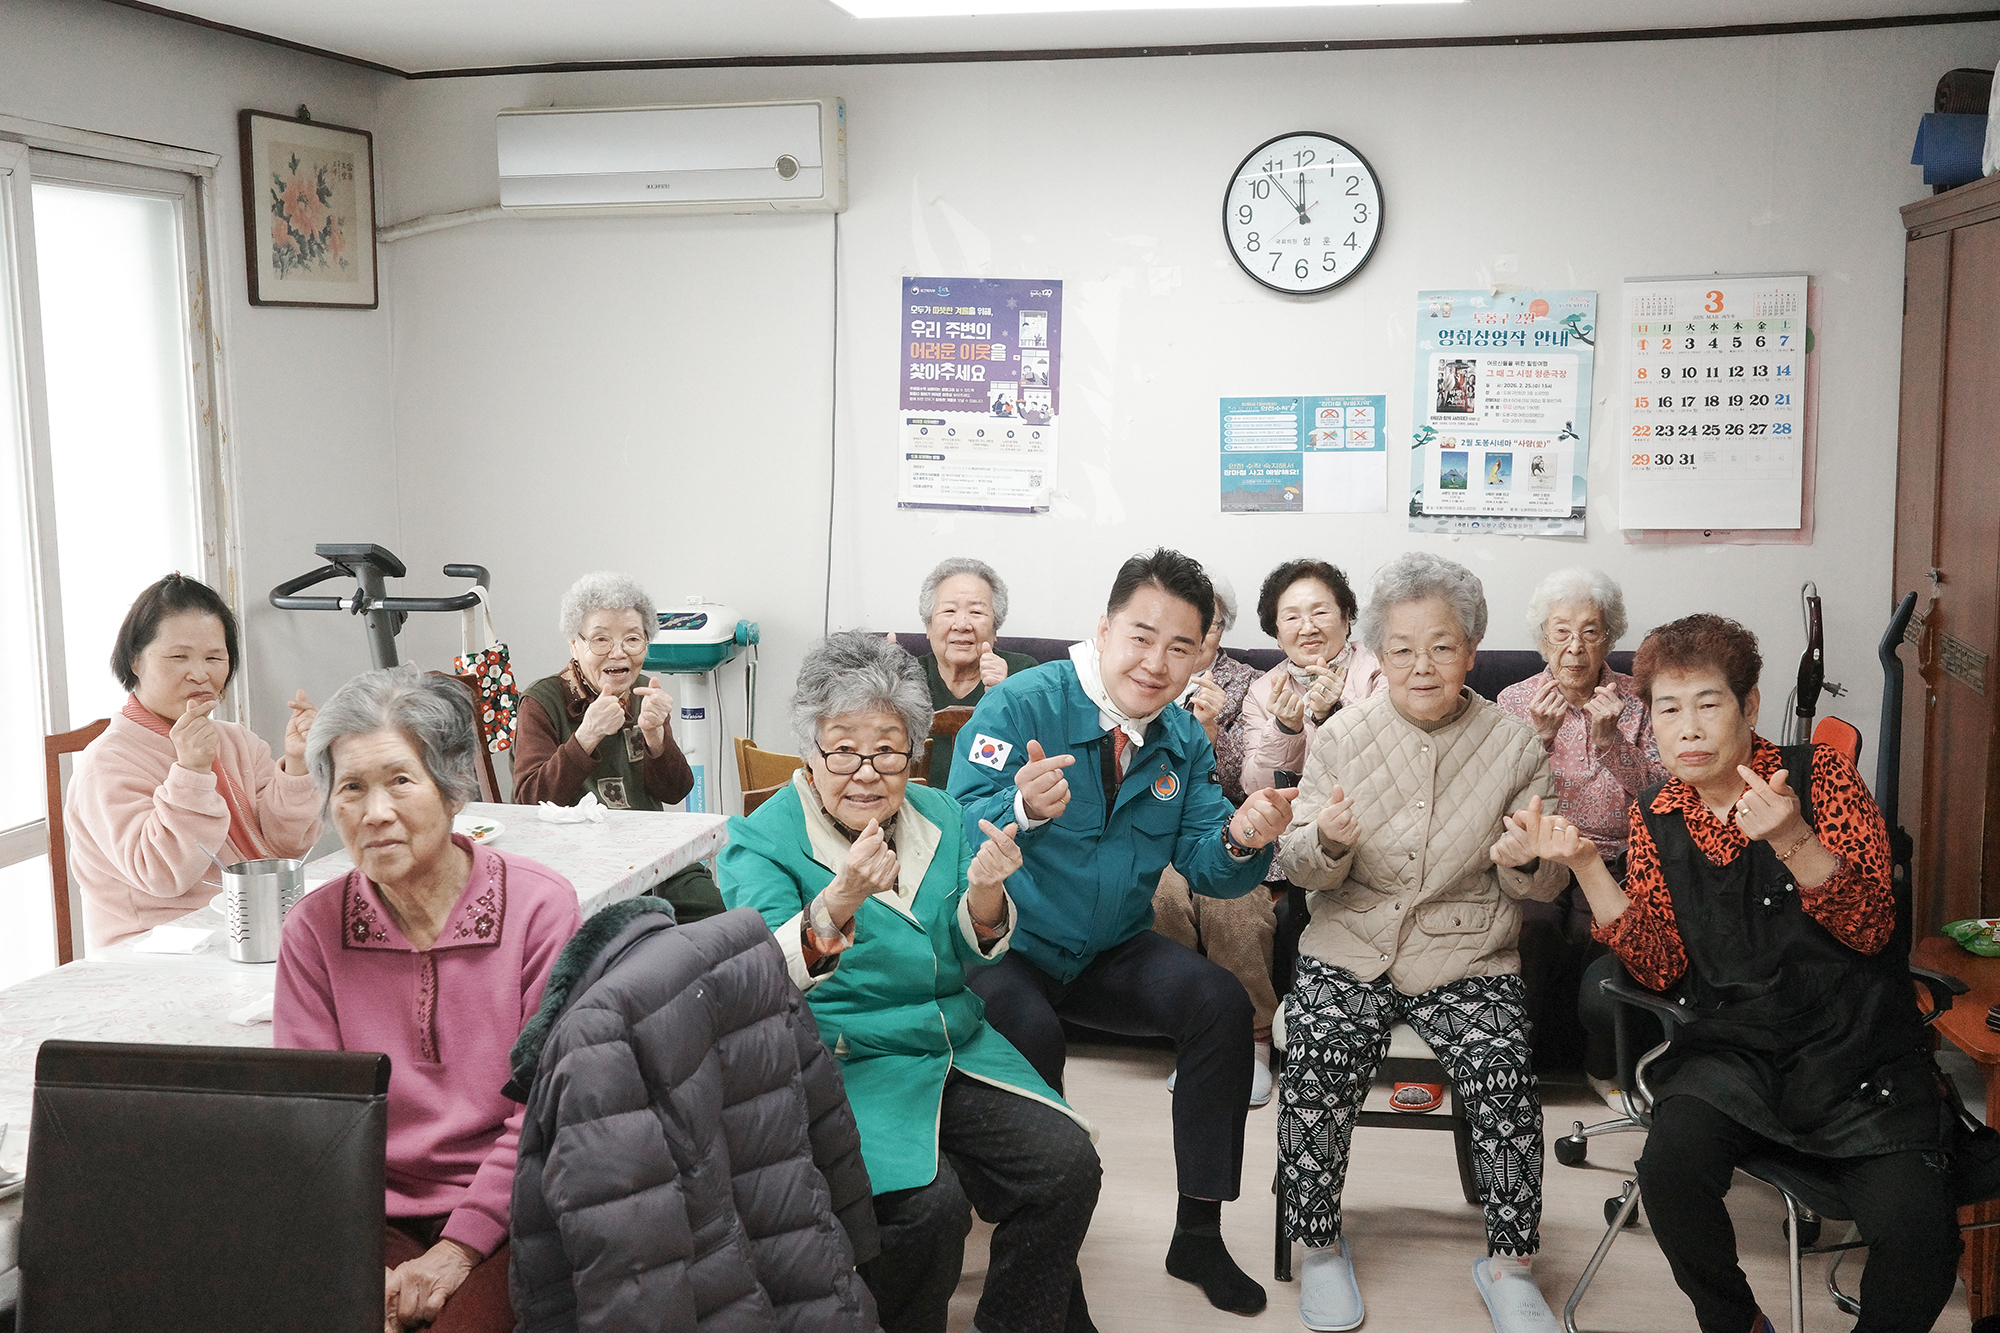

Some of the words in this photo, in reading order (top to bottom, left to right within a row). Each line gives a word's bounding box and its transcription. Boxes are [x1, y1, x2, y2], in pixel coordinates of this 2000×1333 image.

[1265, 160, 1283, 178] 11
[1293, 150, 1315, 169] 12
[1326, 158, 1334, 177] 1
[1249, 180, 1270, 199] 10
[1345, 176, 1359, 195] 2
[1239, 205, 1252, 224] 9
[1354, 204, 1367, 223] 3
[1247, 232, 1260, 251] 8
[1343, 232, 1357, 251] 4
[1269, 252, 1282, 271] 7
[1295, 259, 1308, 278] 6
[1322, 252, 1336, 271] 5
[910, 305, 931, 314] 모두가
[1705, 290, 1724, 313] 3
[1473, 312, 1510, 324] 도봉구
[1515, 312, 1535, 325] 2월
[1662, 324, 1672, 332] 月
[1686, 323, 1695, 331] 火
[1709, 322, 1719, 331] 水
[1758, 321, 1766, 330] 金
[910, 320, 941, 339] 우리
[945, 321, 991, 340] 주변의
[1438, 329, 1526, 347] 영화상영작
[1534, 329, 1569, 347] 안내
[910, 342, 956, 360] 어려운
[960, 343, 1007, 362] 이웃을
[1639, 339, 1646, 350] 1
[1662, 338, 1671, 349] 2
[1685, 338, 1695, 349] 3
[1708, 338, 1718, 348] 4
[1732, 337, 1742, 348] 5
[1755, 336, 1765, 347] 6
[1780, 335, 1789, 346] 7
[909, 362, 986, 382] 찾아주세요
[1506, 370, 1514, 378] 그
[1516, 370, 1532, 378] 시절
[1534, 370, 1567, 378] 청춘극장
[1637, 368, 1647, 379] 8
[1661, 367, 1671, 378] 9
[1682, 367, 1697, 378] 10
[1706, 367, 1718, 378] 11
[1729, 366, 1744, 377] 12
[1753, 365, 1768, 376] 13
[1776, 365, 1791, 376] 14
[1635, 397, 1649, 408] 15
[1658, 396, 1672, 407] 16
[1681, 396, 1696, 407] 17
[1704, 395, 1719, 407] 18
[1728, 395, 1743, 406] 19
[1750, 394, 1769, 406] 20
[1775, 394, 1790, 405] 21
[1632, 425, 1651, 436] 22
[1655, 425, 1674, 436] 23
[1678, 425, 1697, 436] 24
[1702, 424, 1720, 436] 25
[1725, 424, 1744, 435] 26
[1749, 423, 1768, 435] 27
[1772, 423, 1792, 434] 28
[1475, 439, 1512, 447] 도봉시네마
[1632, 454, 1650, 465] 29
[1655, 454, 1674, 465] 30
[1679, 454, 1695, 465] 31
